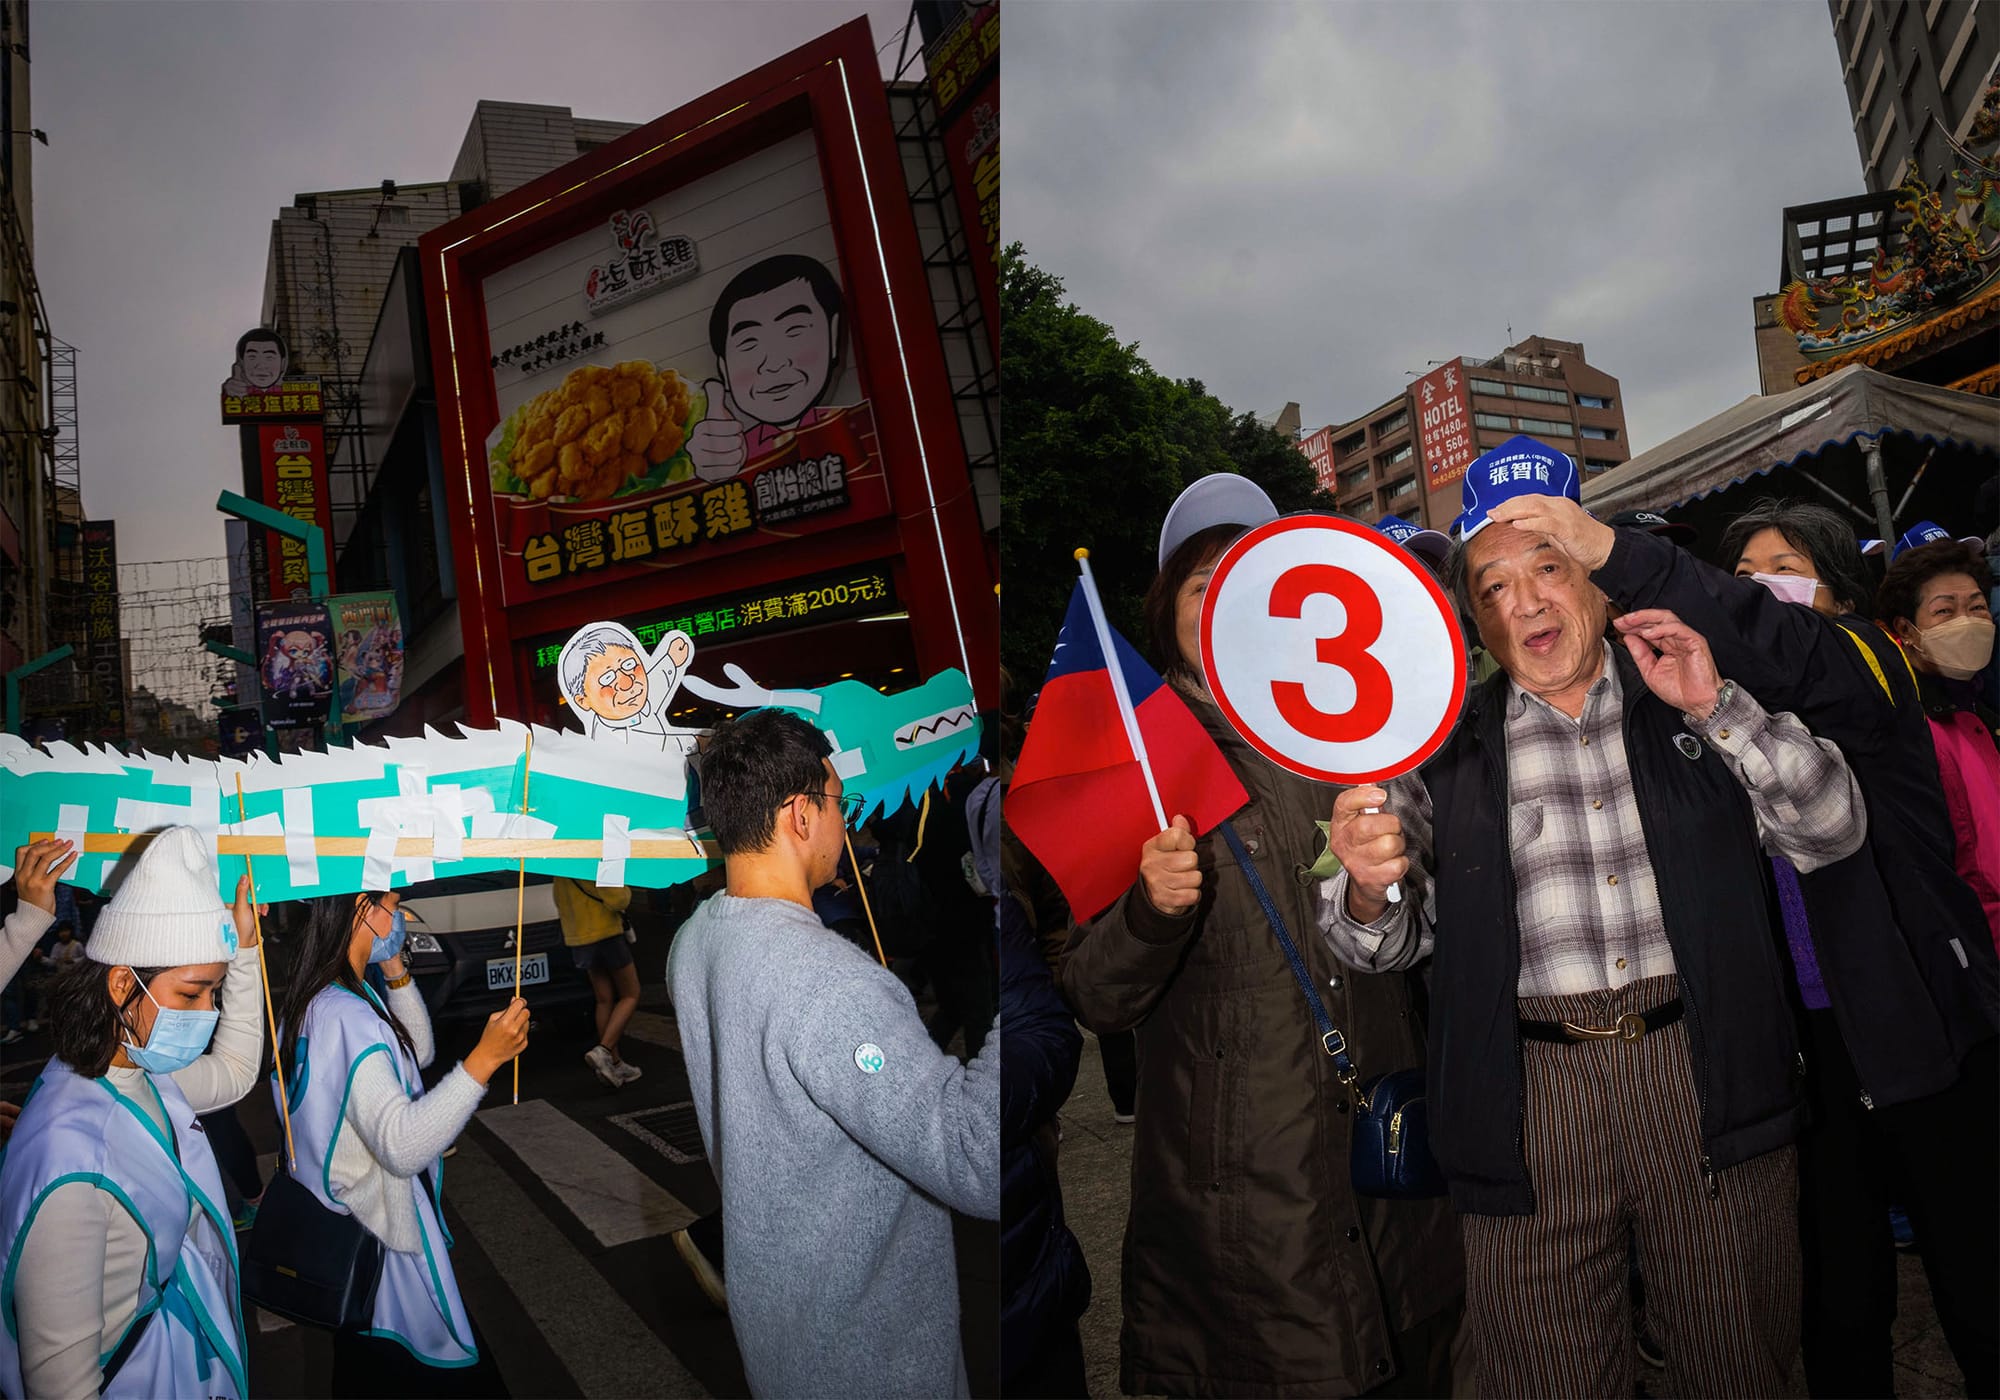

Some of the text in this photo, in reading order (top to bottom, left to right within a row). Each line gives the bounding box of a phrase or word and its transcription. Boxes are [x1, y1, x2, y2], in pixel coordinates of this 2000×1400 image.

[1421, 367, 1458, 404] 全家
[1423, 395, 1463, 430] HOTEL
[1269, 564, 1393, 743] 3
